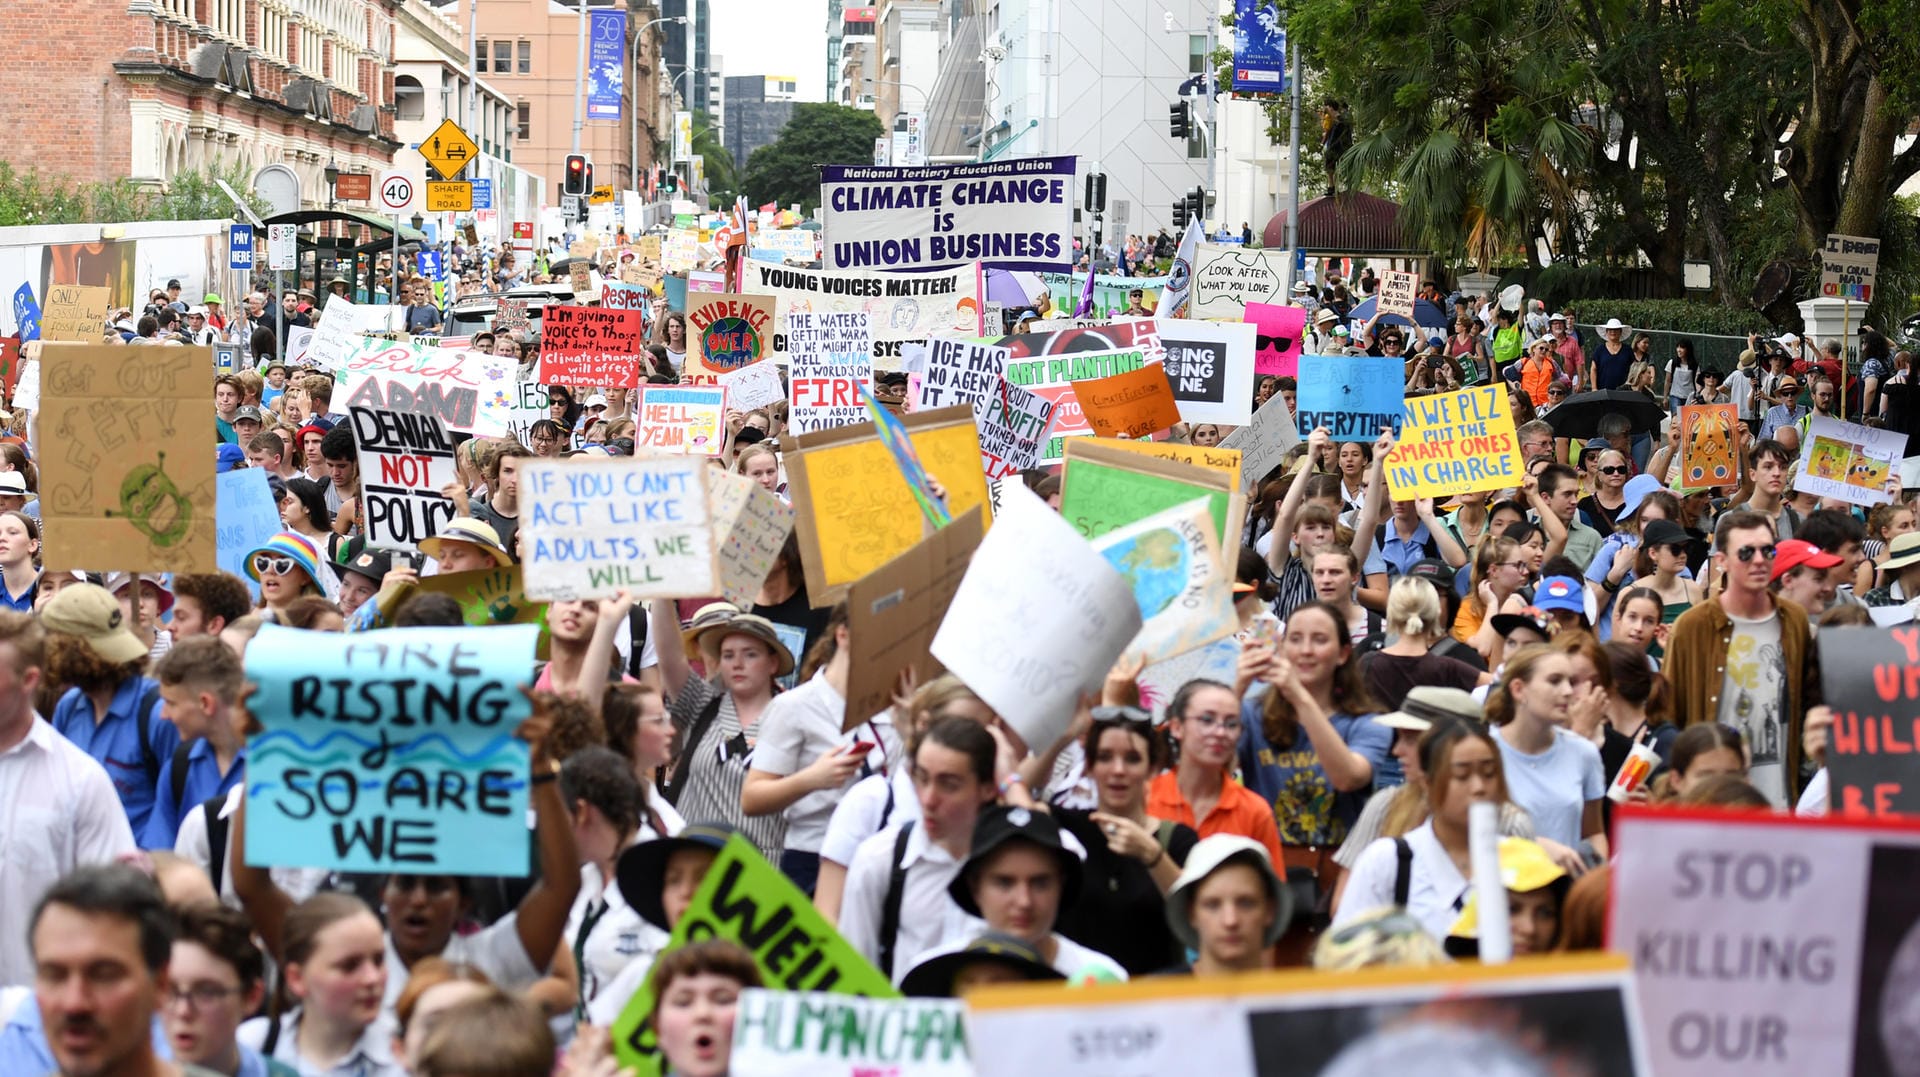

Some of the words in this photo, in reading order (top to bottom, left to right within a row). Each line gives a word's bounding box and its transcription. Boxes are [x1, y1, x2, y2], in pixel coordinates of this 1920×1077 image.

[596, 16, 620, 41] 30
[844, 168, 897, 178] National
[902, 168, 949, 179] Tertiary
[953, 165, 1012, 175] Education
[1016, 161, 1053, 171] Union
[385, 184, 409, 200] 40
[434, 185, 465, 193] SHARE
[831, 184, 943, 212] CLIMATE
[951, 178, 1065, 206] CHANGE
[933, 208, 955, 233] is
[233, 231, 249, 245] PAY
[834, 238, 922, 268] UNION
[930, 232, 1061, 262] BUSINESS
[1827, 238, 1840, 252] I
[231, 251, 251, 264] HERE
[760, 267, 820, 291] YOUNG
[822, 273, 882, 298] VOICES
[886, 275, 957, 297] MATTER!
[1209, 265, 1234, 277] LOOK
[1239, 267, 1268, 278] AFTER
[1847, 265, 1872, 276] CORAL
[51, 288, 81, 304] ONLY
[601, 284, 649, 310] Respect
[1200, 281, 1226, 290] WHAT
[1229, 281, 1245, 291] YOU
[1248, 282, 1270, 293] LOVE
[577, 311, 615, 325] giving
[617, 314, 624, 322] a
[689, 300, 770, 333] EVIDENCE
[789, 314, 812, 329] THE
[818, 313, 867, 328] WATER'S
[545, 324, 579, 338] voice
[582, 325, 596, 338] to
[601, 326, 636, 341] those
[707, 332, 753, 352] OVER
[791, 329, 836, 342] GETTING
[839, 329, 869, 341] WARM
[543, 339, 569, 351] that
[572, 340, 594, 350] don't
[596, 341, 621, 352] have
[545, 351, 592, 365] Climate
[594, 352, 639, 364] change
[789, 343, 799, 354] SO
[804, 342, 816, 353] WE
[822, 341, 852, 353] MIGHT
[857, 341, 868, 352] AS
[792, 354, 821, 365] WELL
[828, 351, 870, 364] SWIM
[931, 340, 964, 367] ICE
[968, 346, 1006, 374] HAS
[220, 353, 230, 365] P
[568, 363, 591, 374] will
[595, 363, 634, 374] affect
[792, 366, 807, 377] MY
[812, 365, 855, 377] WORLD'S
[857, 365, 871, 376] ON
[1048, 351, 1145, 382] PLANTING
[116, 351, 192, 394] OUT
[618, 374, 631, 387] 2
[927, 366, 947, 386] NO
[1304, 361, 1397, 386] EARTH
[792, 379, 869, 406] FIRE
[922, 387, 943, 407] IT
[645, 404, 693, 423] HELL
[794, 407, 818, 416] HOW
[829, 406, 864, 416] ABOUT
[986, 398, 1046, 440] PROFIT
[1421, 397, 1450, 425] WE
[1457, 388, 1501, 422] PLZ
[350, 406, 453, 451] DENIAL
[1299, 410, 1401, 436] EVERYTHING
[1423, 423, 1454, 442] PUT
[1457, 421, 1487, 437] THE
[642, 426, 683, 447] YEAH
[983, 421, 1016, 445] TURNED
[1018, 437, 1038, 457] OUR
[1388, 438, 1455, 464] SMART
[1460, 433, 1512, 456] ONES
[979, 434, 1011, 458] PLANET
[1010, 451, 1030, 469] INTO
[1028, 459, 1038, 472] A
[380, 454, 433, 488] NOT
[1391, 466, 1416, 489] IN
[1423, 454, 1513, 485] CHARGE
[531, 471, 555, 494] IF
[566, 470, 613, 498] YOU
[1812, 478, 1842, 494] RIGHT
[1847, 487, 1870, 500] NOW
[533, 501, 588, 528] ACT
[608, 499, 682, 524] LIKE
[653, 534, 695, 556] WE
[587, 564, 663, 589] WILL
[345, 642, 481, 677] ARE
[290, 675, 510, 727] RISING
[275, 768, 358, 820] SO
[385, 767, 515, 817] ARE
[1843, 784, 1904, 821] BE
[331, 816, 438, 863] WE
[1672, 850, 1814, 905] STOP
[1634, 930, 1838, 986] KILLING
[1666, 1010, 1792, 1063] OUR
